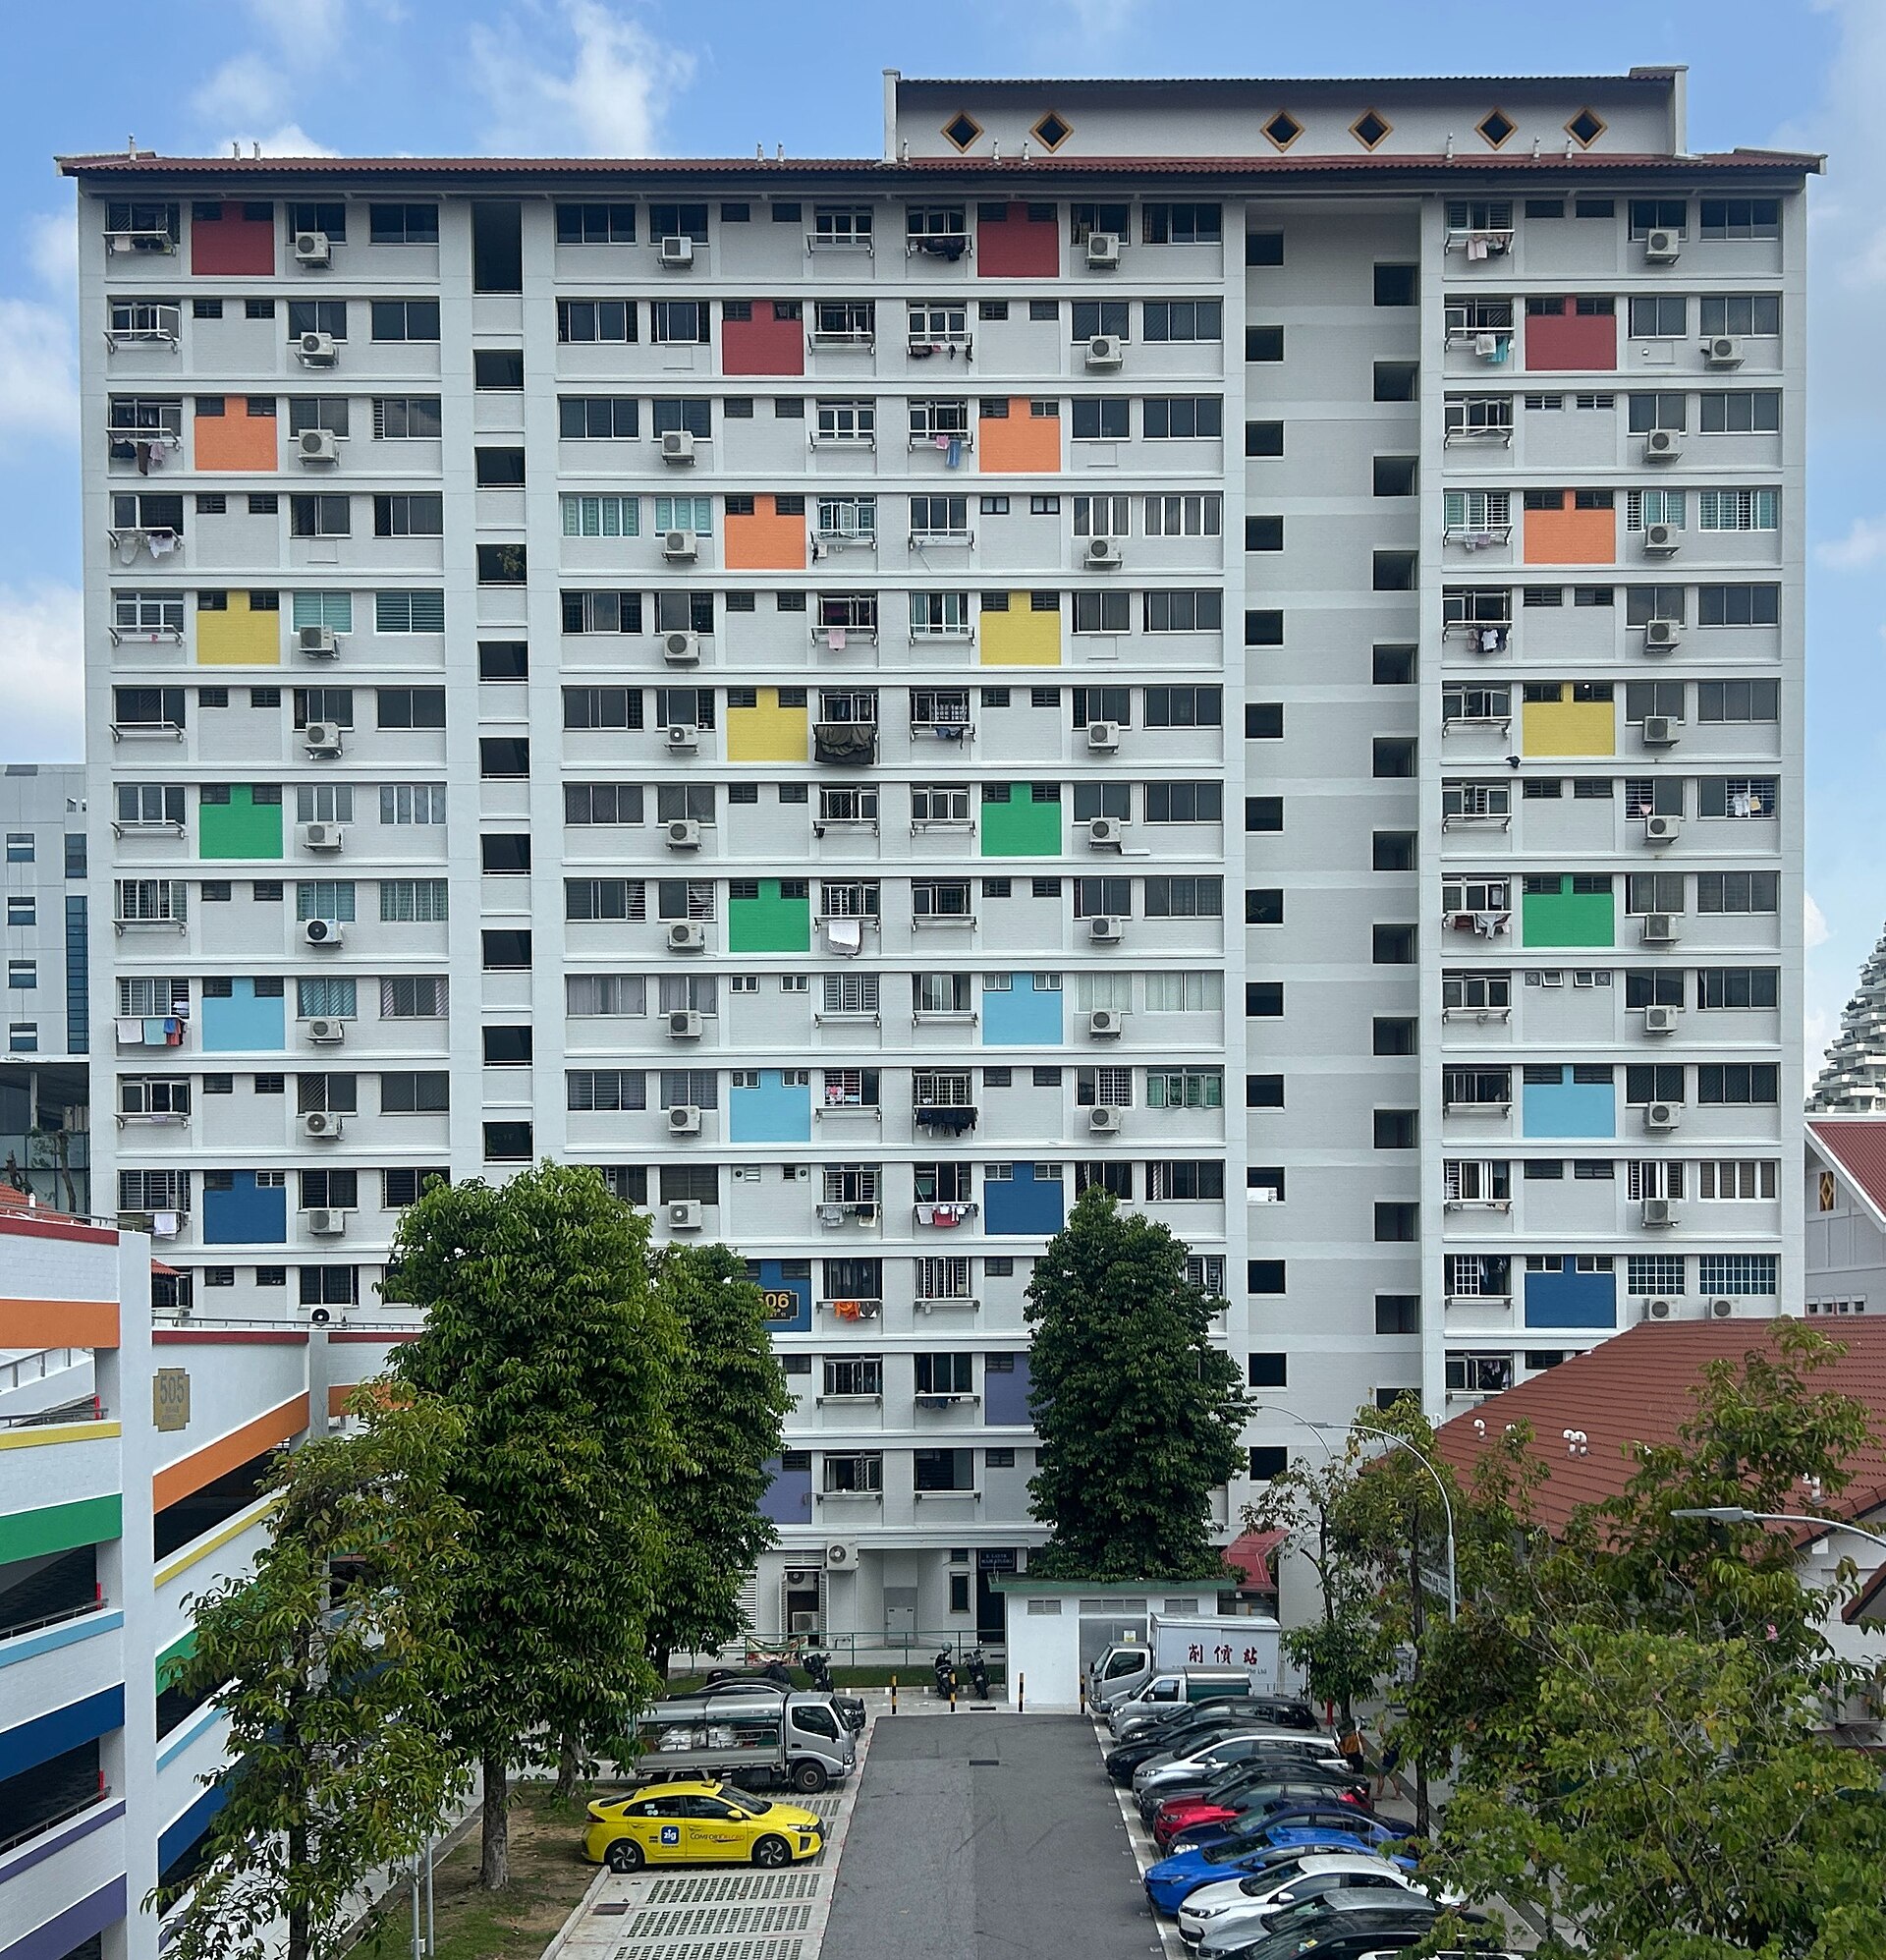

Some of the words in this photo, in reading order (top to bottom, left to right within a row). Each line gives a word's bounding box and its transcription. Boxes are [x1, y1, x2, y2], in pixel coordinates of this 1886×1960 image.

[757, 1293, 789, 1308] 06
[160, 1375, 184, 1404] 505
[663, 1829, 677, 1841] zig
